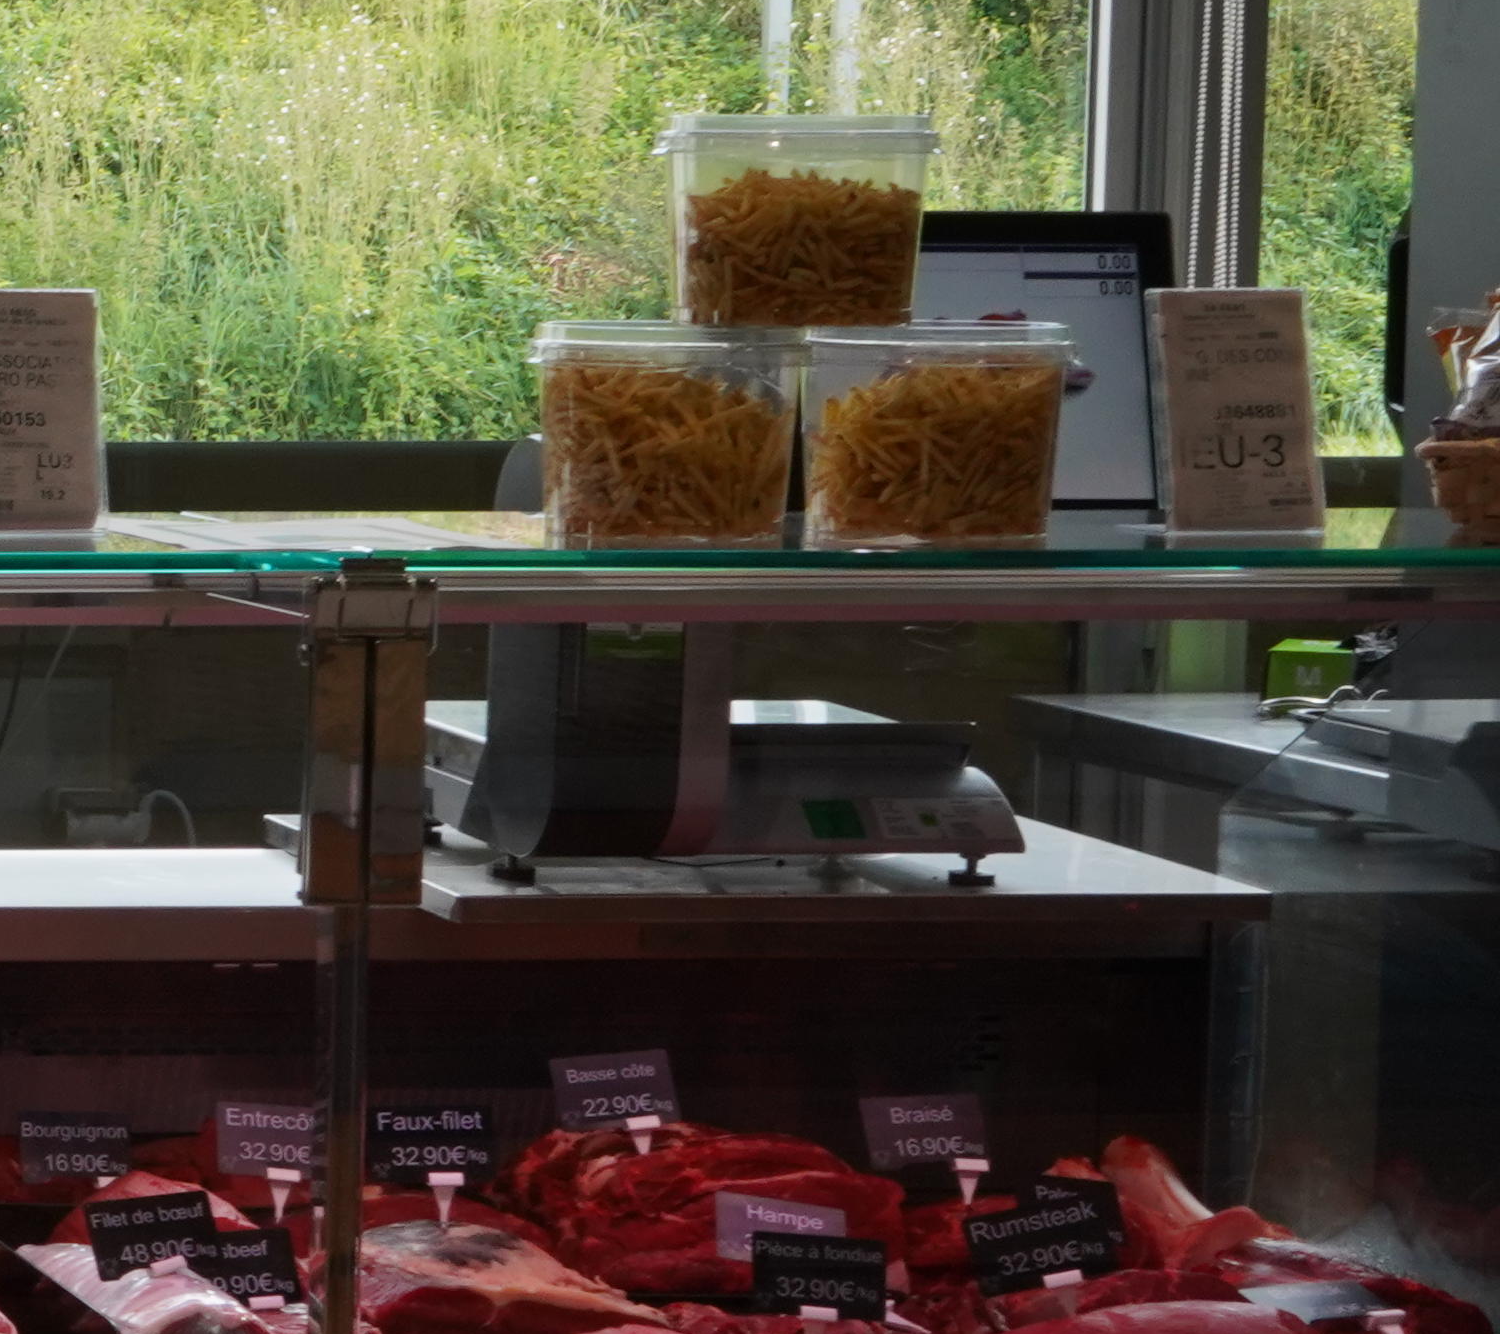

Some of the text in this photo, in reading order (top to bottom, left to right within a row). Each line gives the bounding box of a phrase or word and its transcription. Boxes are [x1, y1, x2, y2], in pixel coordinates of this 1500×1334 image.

[1097, 254, 1132, 270] 0.00
[1100, 279, 1134, 296] 0.00
[564, 1062, 657, 1085] Basse côte
[375, 1110, 484, 1133] Faux-filet
[888, 1105, 955, 1126] Braisé
[19, 1120, 129, 1143] Bourguignon
[90, 1210, 129, 1230] Filet
[131, 1208, 156, 1225] de
[746, 1204, 825, 1232] Hampe
[968, 1200, 1100, 1245] Rumsteak
[754, 1240, 806, 1259] Pièce
[808, 1241, 820, 1260] à
[823, 1244, 884, 1265] fondue
